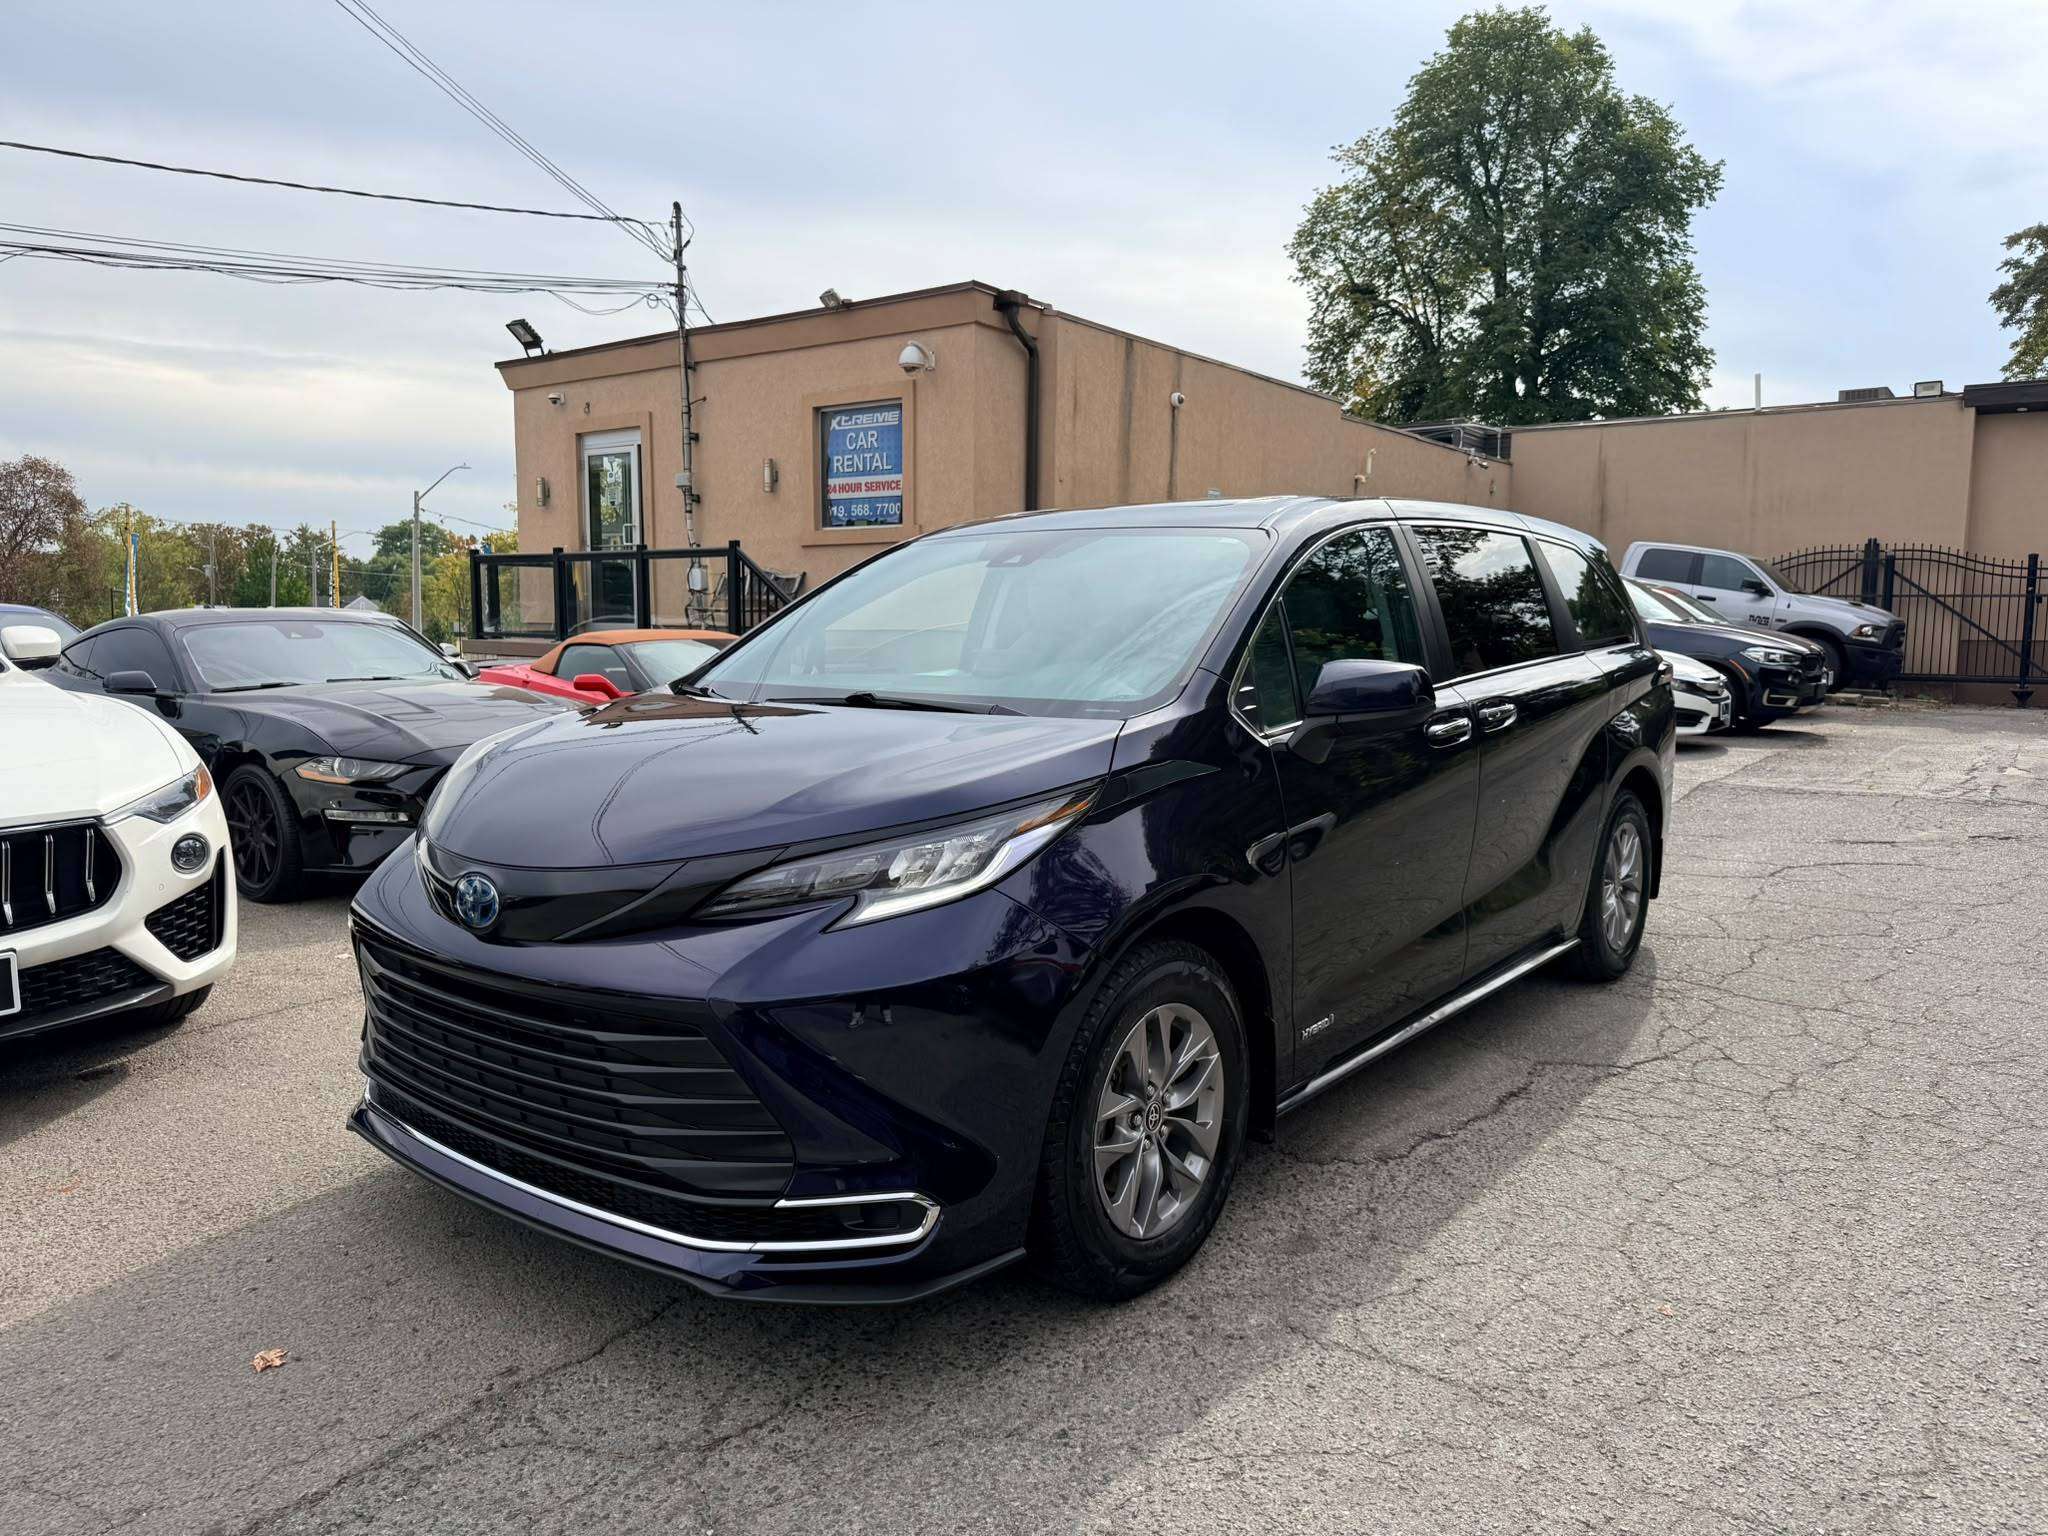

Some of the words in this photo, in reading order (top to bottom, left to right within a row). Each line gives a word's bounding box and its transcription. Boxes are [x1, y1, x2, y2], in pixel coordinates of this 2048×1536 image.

[846, 430, 879, 450] CAR
[833, 453, 892, 473] RENTAL
[838, 482, 862, 494] HOUR
[864, 480, 901, 492] SERVICE
